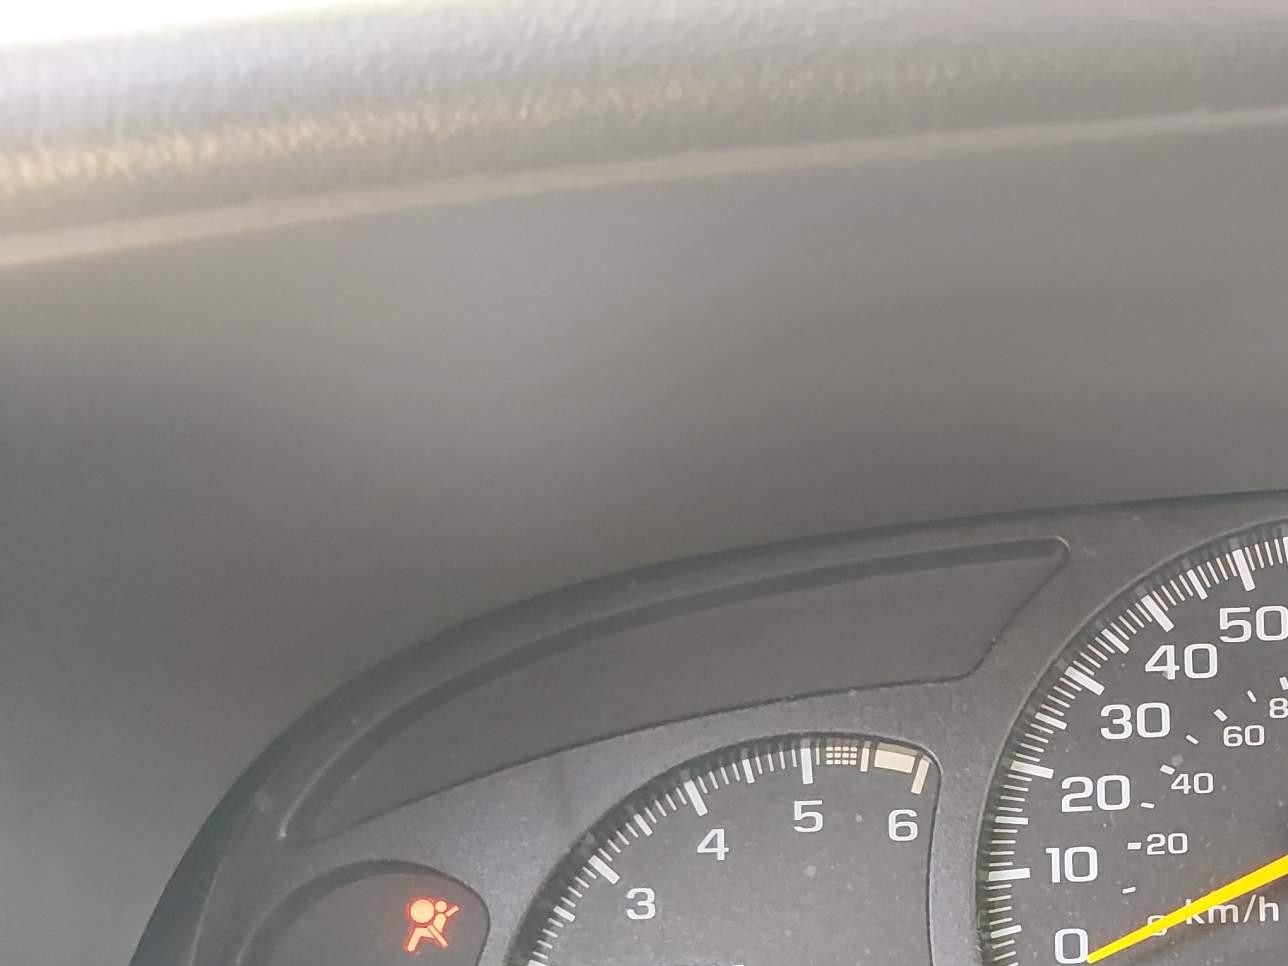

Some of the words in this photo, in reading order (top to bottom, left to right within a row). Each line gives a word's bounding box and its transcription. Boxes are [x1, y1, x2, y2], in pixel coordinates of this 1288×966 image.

[1144, 643, 1218, 680] 40
[1100, 702, 1171, 740] 30
[1223, 724, 1265, 747] 60
[1061, 774, 1131, 813] 20
[1168, 771, 1214, 795] 40
[793, 799, 824, 833] 5
[888, 809, 918, 842] 6
[696, 828, 730, 861] 4
[1146, 832, 1188, 856] 20
[1048, 846, 1098, 883] 10
[626, 887, 656, 920] 3
[1054, 928, 1090, 964] 0
